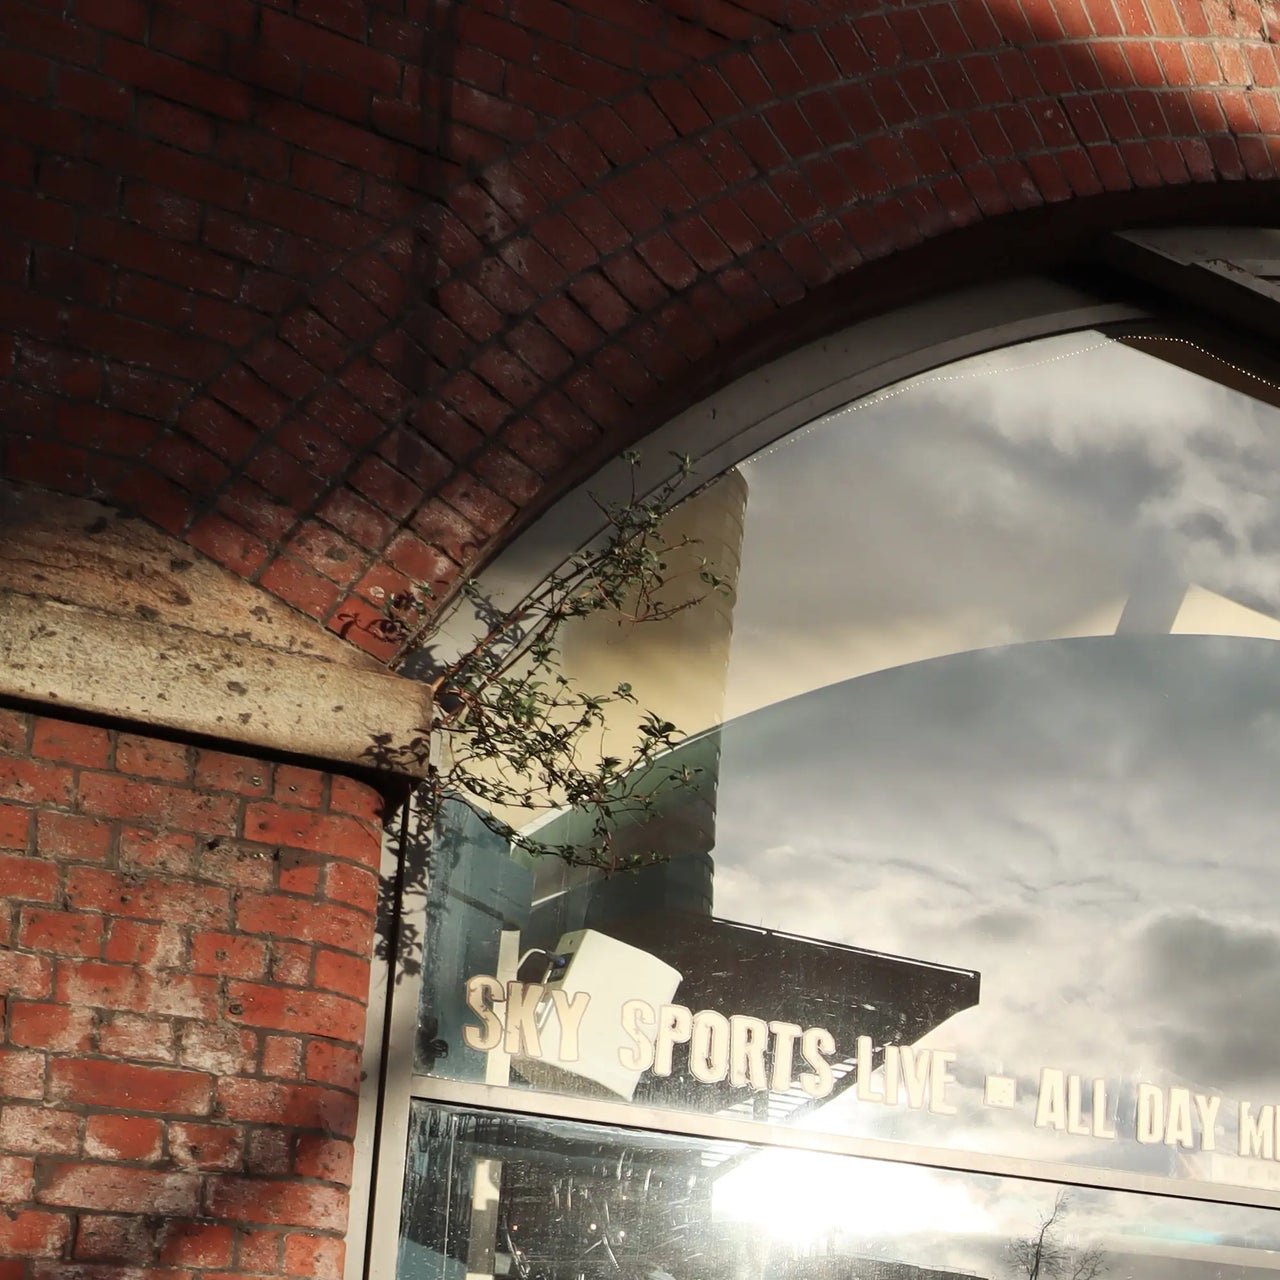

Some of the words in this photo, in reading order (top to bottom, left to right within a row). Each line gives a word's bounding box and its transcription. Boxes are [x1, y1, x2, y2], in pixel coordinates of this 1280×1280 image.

[462, 974, 592, 1063] SKY
[617, 998, 837, 1099] SPORTS
[855, 1034, 960, 1117] LIVE
[1034, 1067, 1117, 1140] ALL
[1135, 1081, 1221, 1152] DAY
